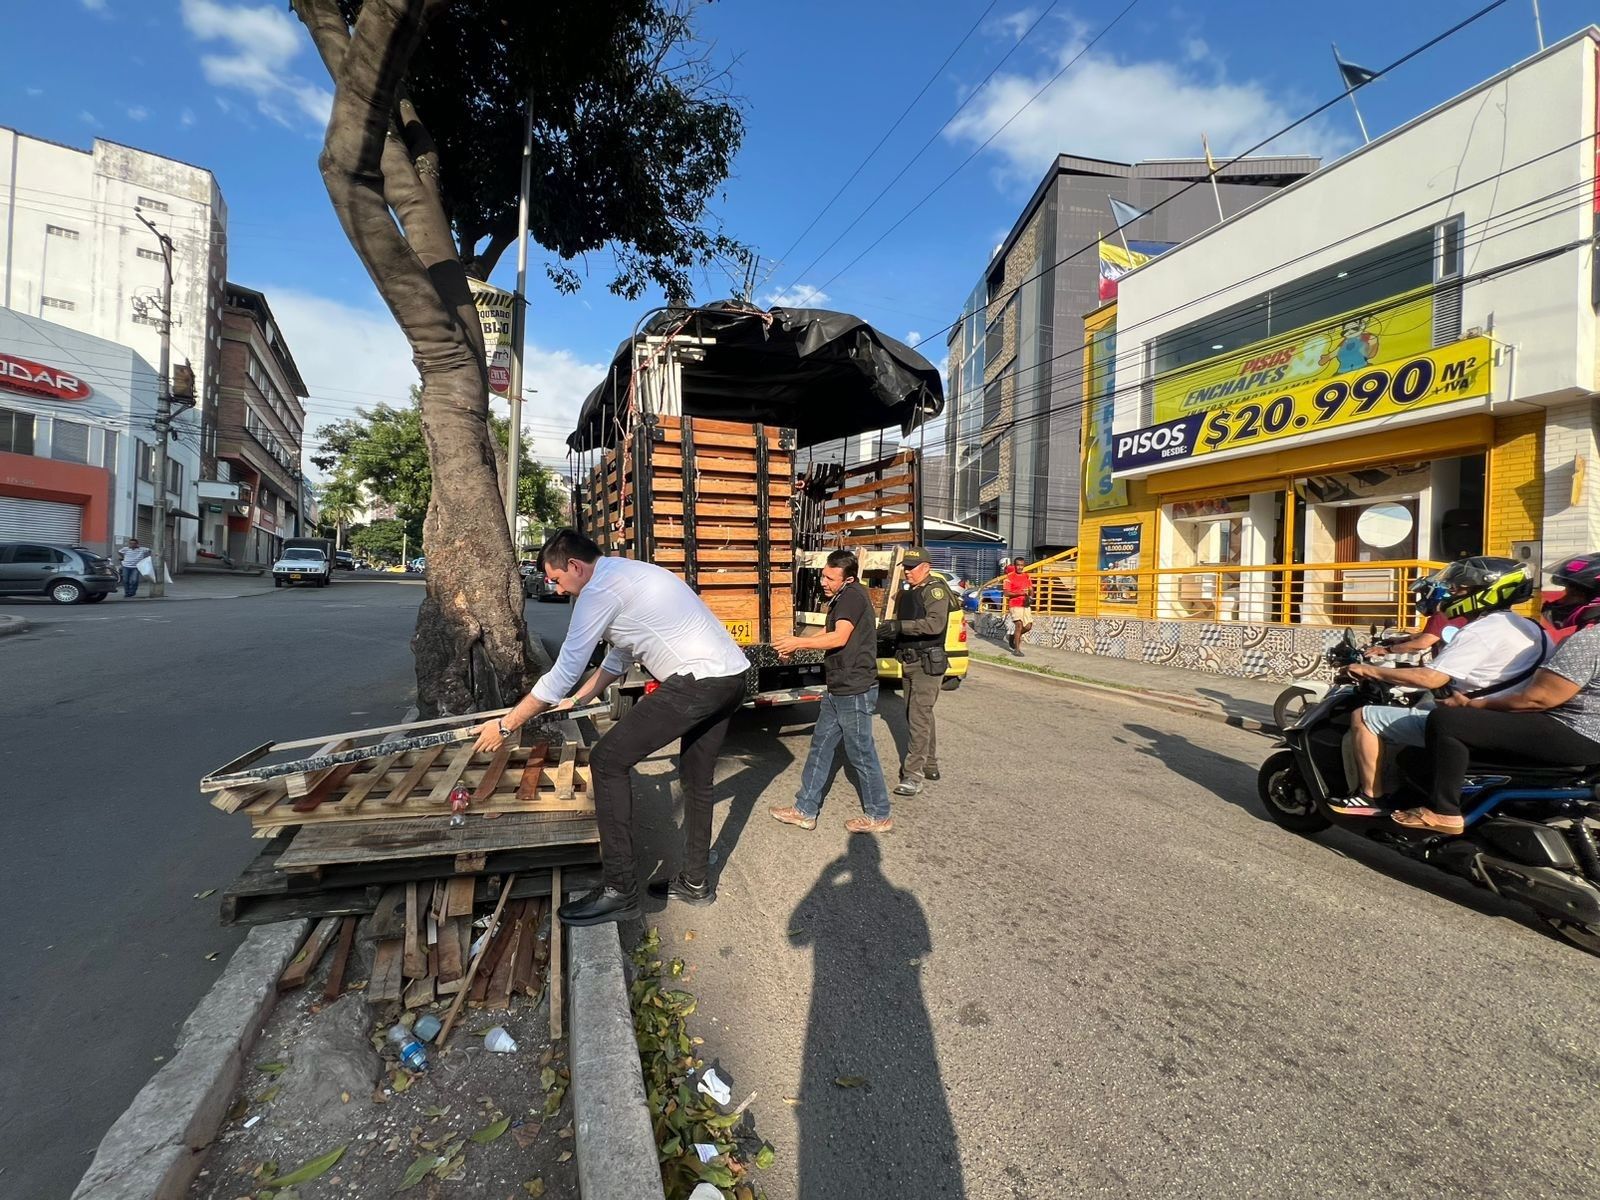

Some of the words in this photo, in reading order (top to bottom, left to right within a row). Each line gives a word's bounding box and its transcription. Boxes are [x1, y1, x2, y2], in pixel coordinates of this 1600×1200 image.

[1239, 347, 1297, 377] PISOS
[1184, 364, 1289, 407] ENCHAPES
[1202, 356, 1436, 451] $20.990
[1117, 423, 1187, 459] PISOS
[1161, 445, 1188, 458] DESDE:
